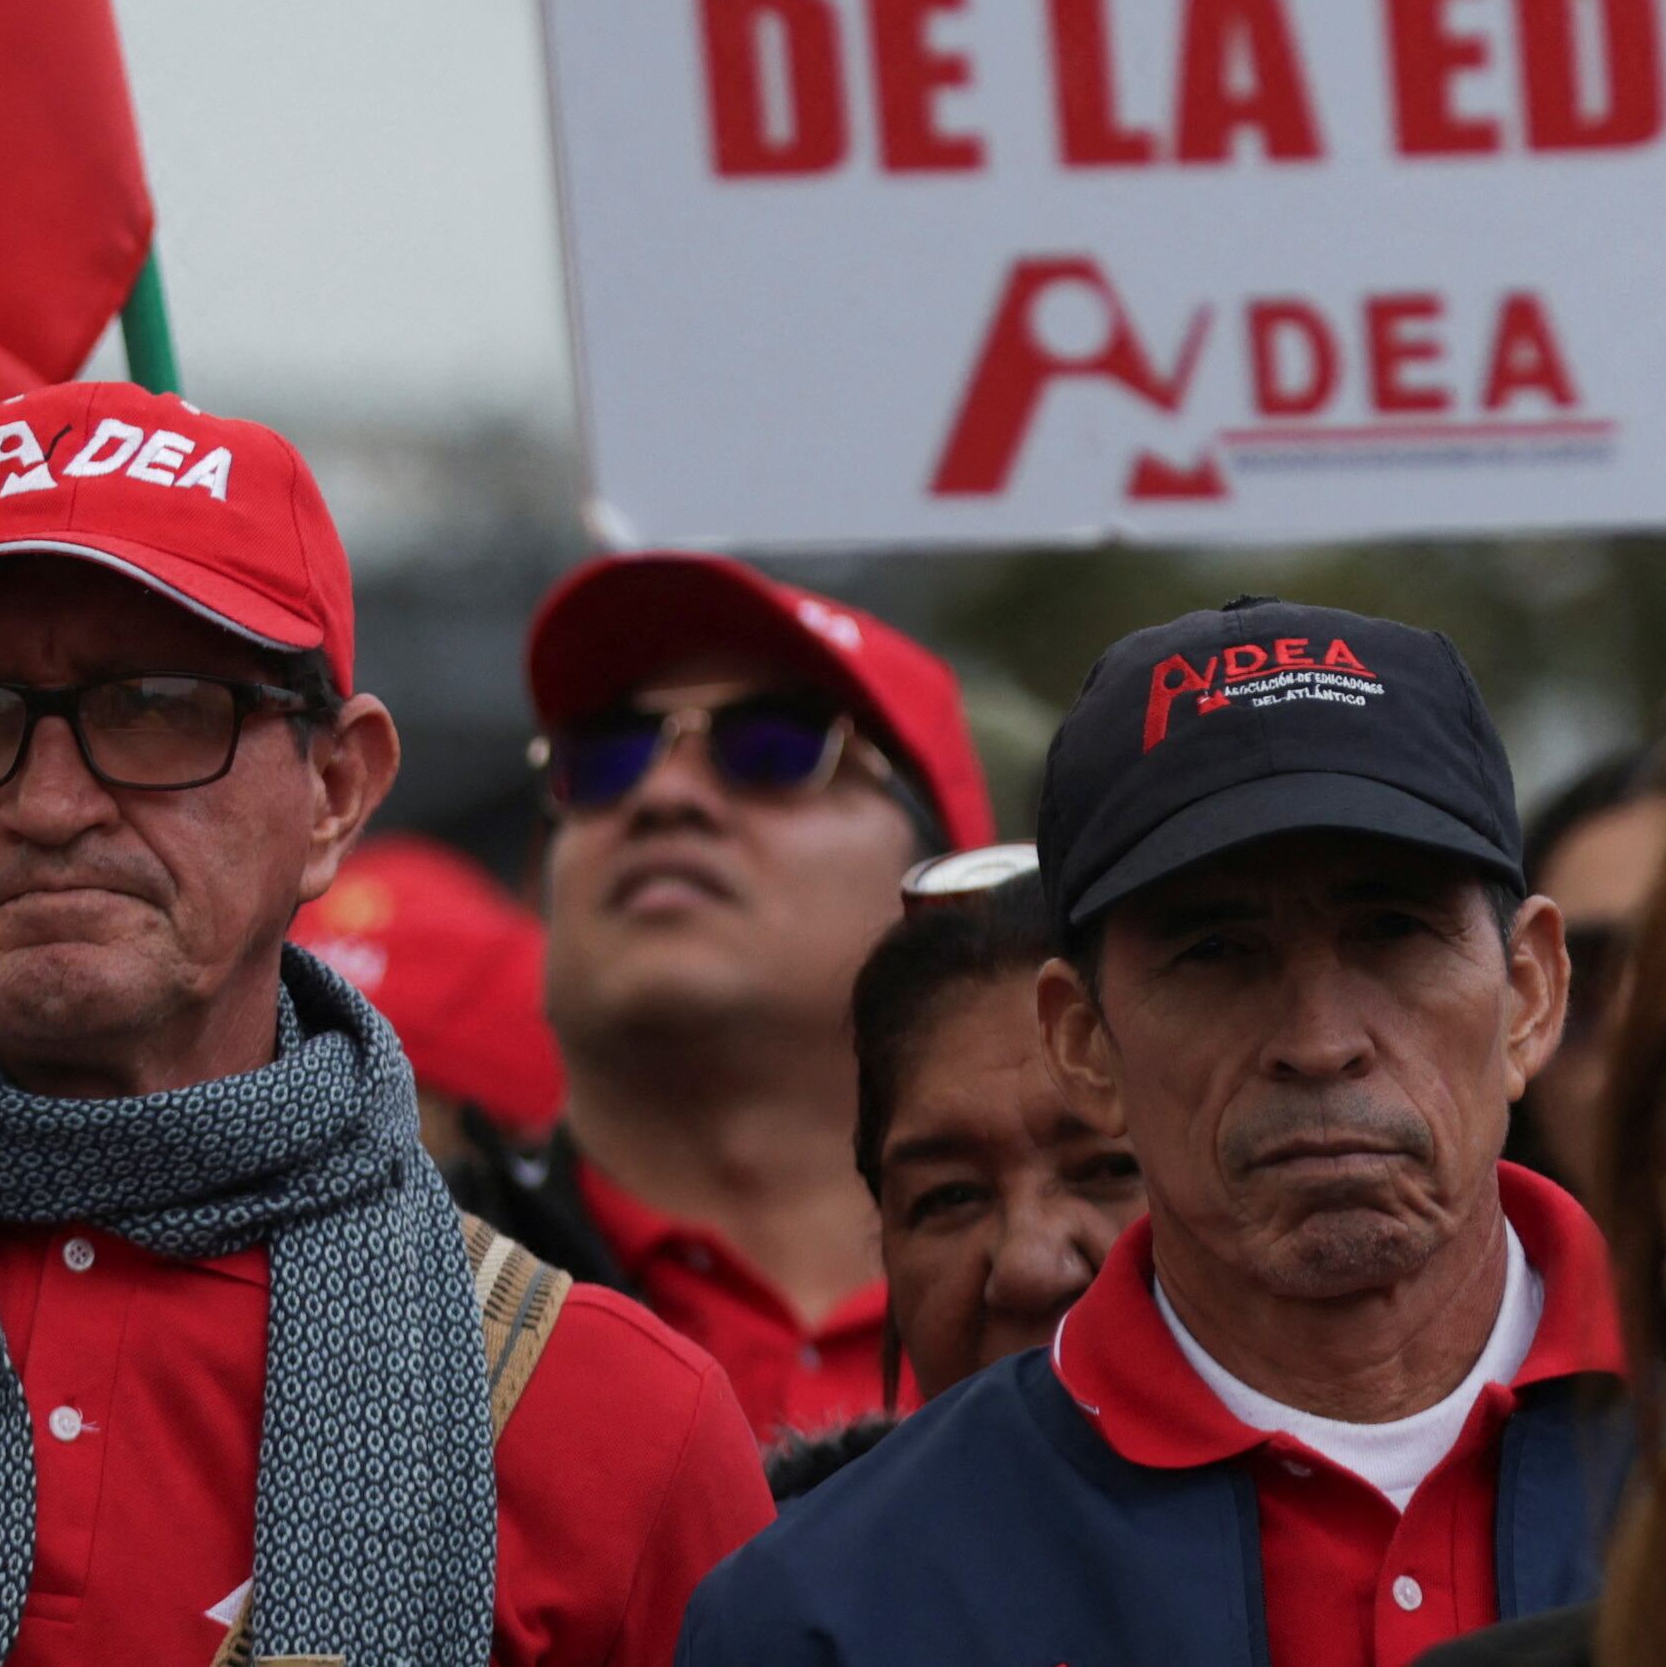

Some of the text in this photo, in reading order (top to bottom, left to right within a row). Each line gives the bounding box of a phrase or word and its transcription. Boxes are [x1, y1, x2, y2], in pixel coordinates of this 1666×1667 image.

[928, 255, 1579, 501] ADEA
[1143, 637, 1368, 755] ADEA
[1224, 671, 1385, 696] ASOCIACIÓN DE EDUCADORES
[1252, 684, 1366, 708] DEL ATLÁNTICO
